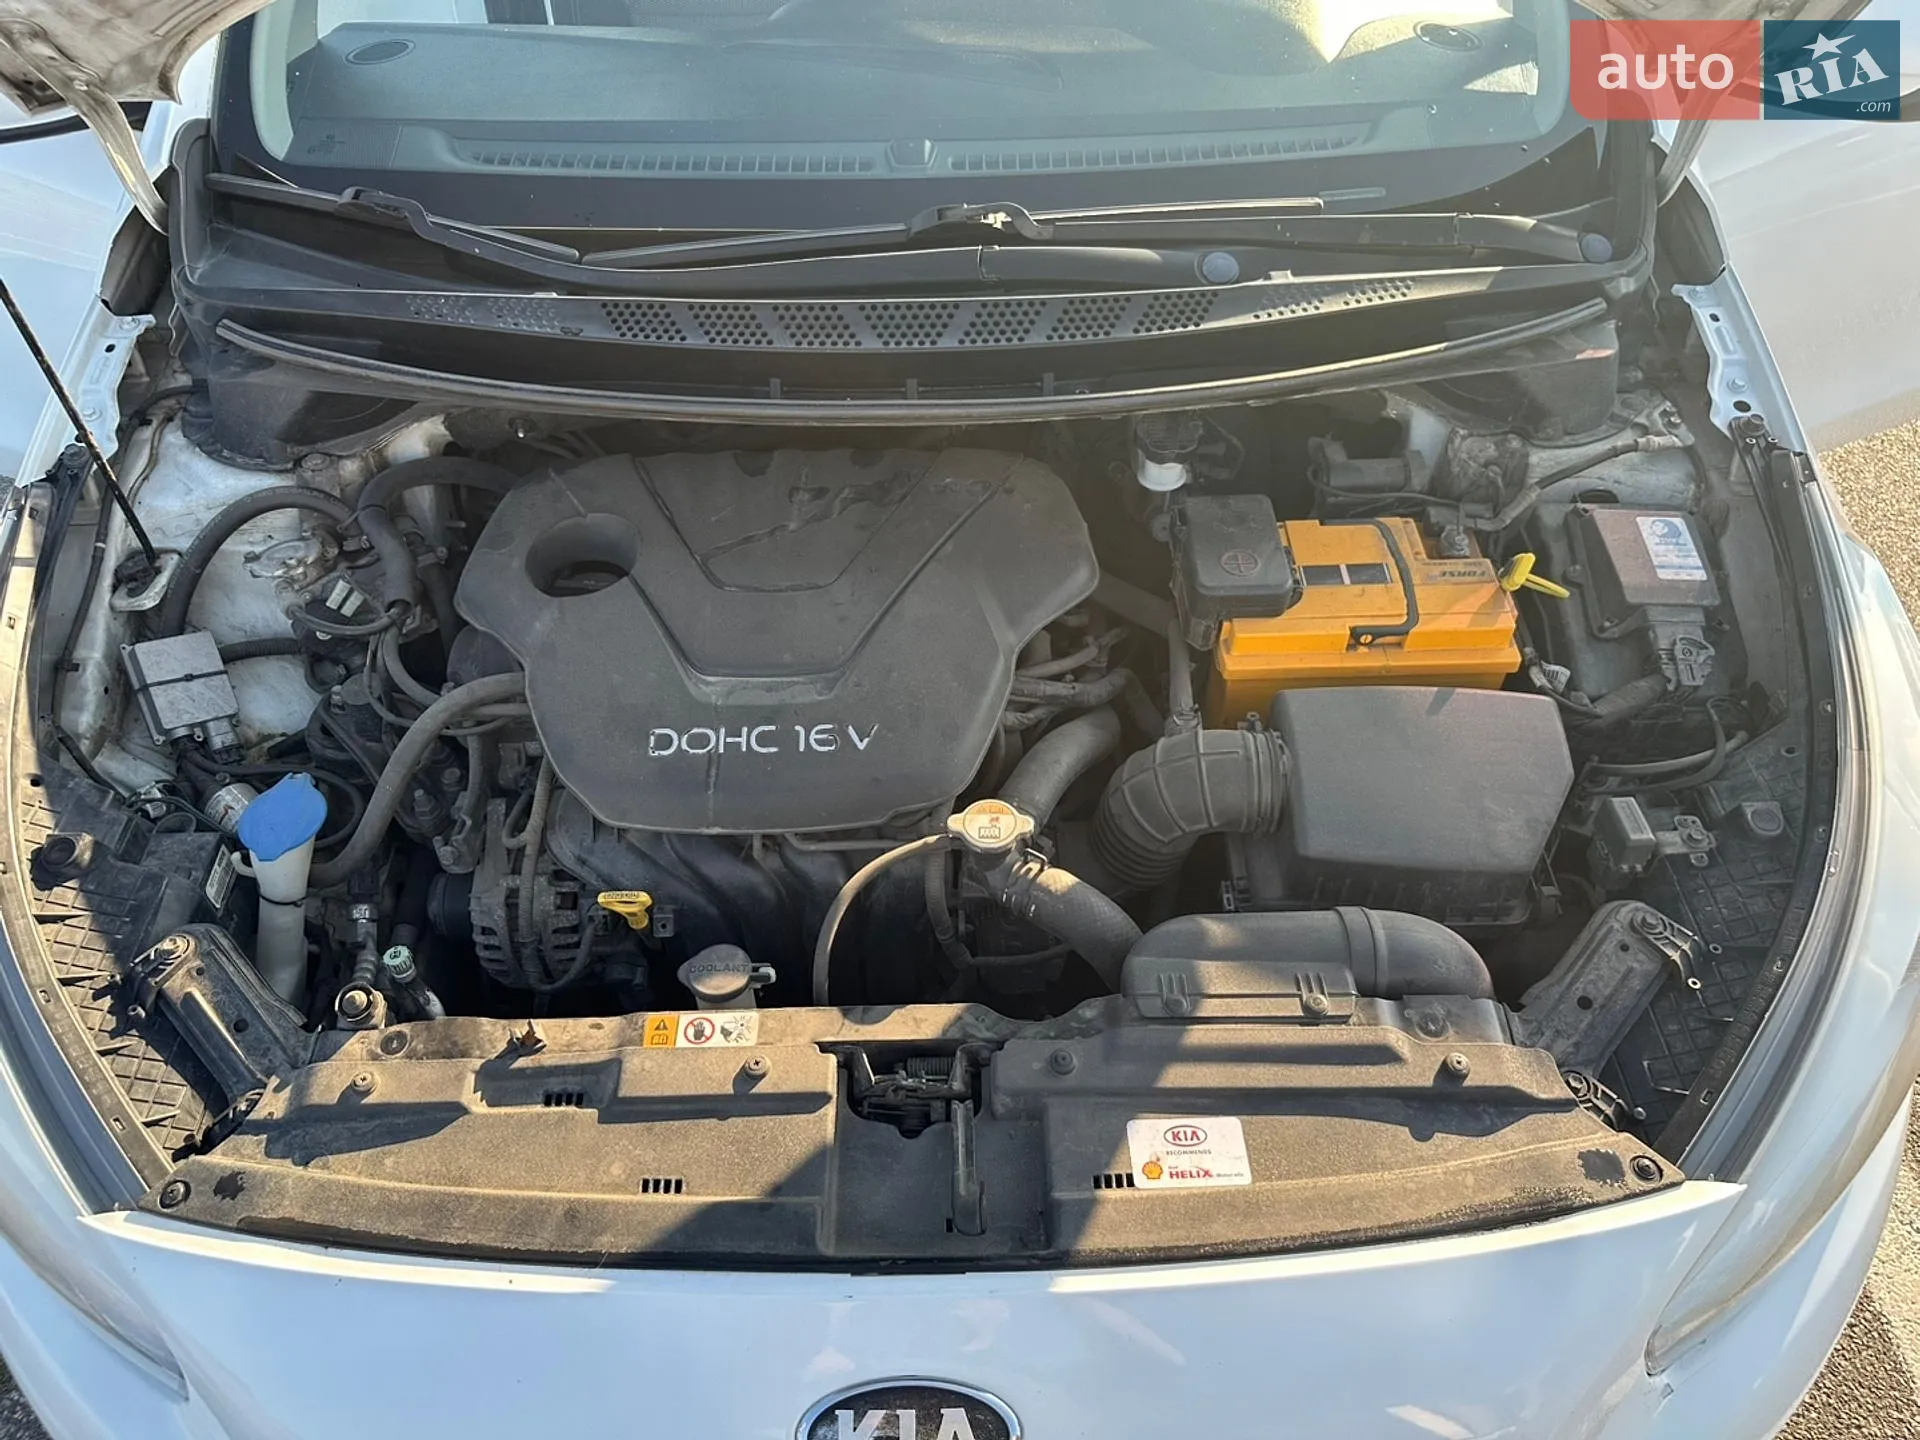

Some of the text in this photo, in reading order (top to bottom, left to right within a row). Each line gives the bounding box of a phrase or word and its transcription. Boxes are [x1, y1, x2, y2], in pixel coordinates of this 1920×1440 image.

[649, 723, 880, 756] DOHC 16 V
[689, 962, 749, 974] COOLANT
[1171, 1129, 1201, 1142] KIA
[1168, 1168, 1215, 1180] HELIX
[834, 1407, 976, 1440] KIA
